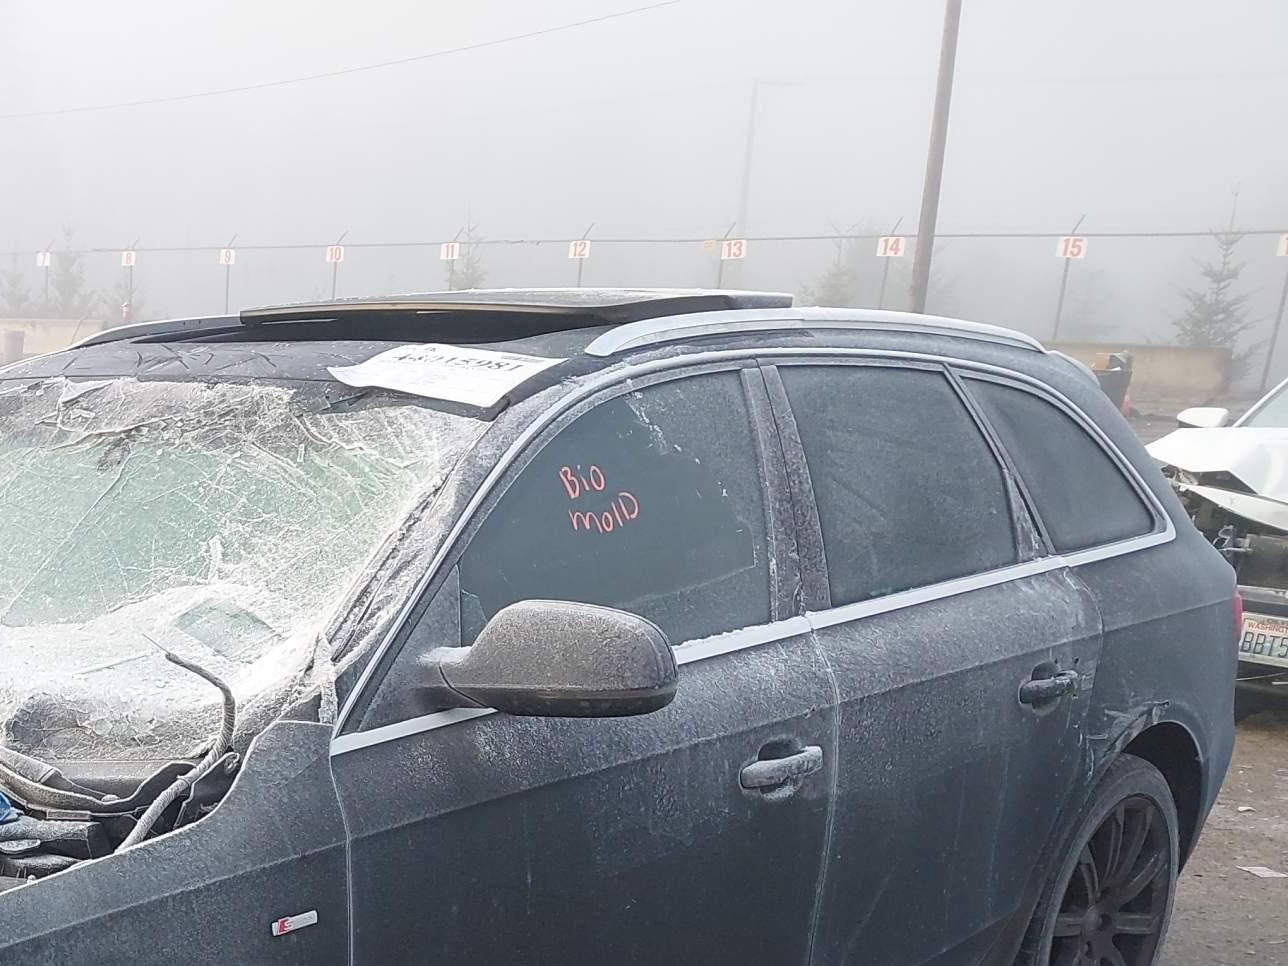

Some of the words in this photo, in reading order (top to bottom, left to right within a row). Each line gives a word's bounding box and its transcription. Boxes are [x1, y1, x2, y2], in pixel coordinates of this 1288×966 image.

[328, 246, 342, 261] 10
[445, 244, 455, 258] 11
[573, 241, 587, 257] 12
[726, 241, 742, 257] 13
[882, 238, 900, 255] 14
[1062, 238, 1083, 257] 15
[224, 250, 231, 263] 9
